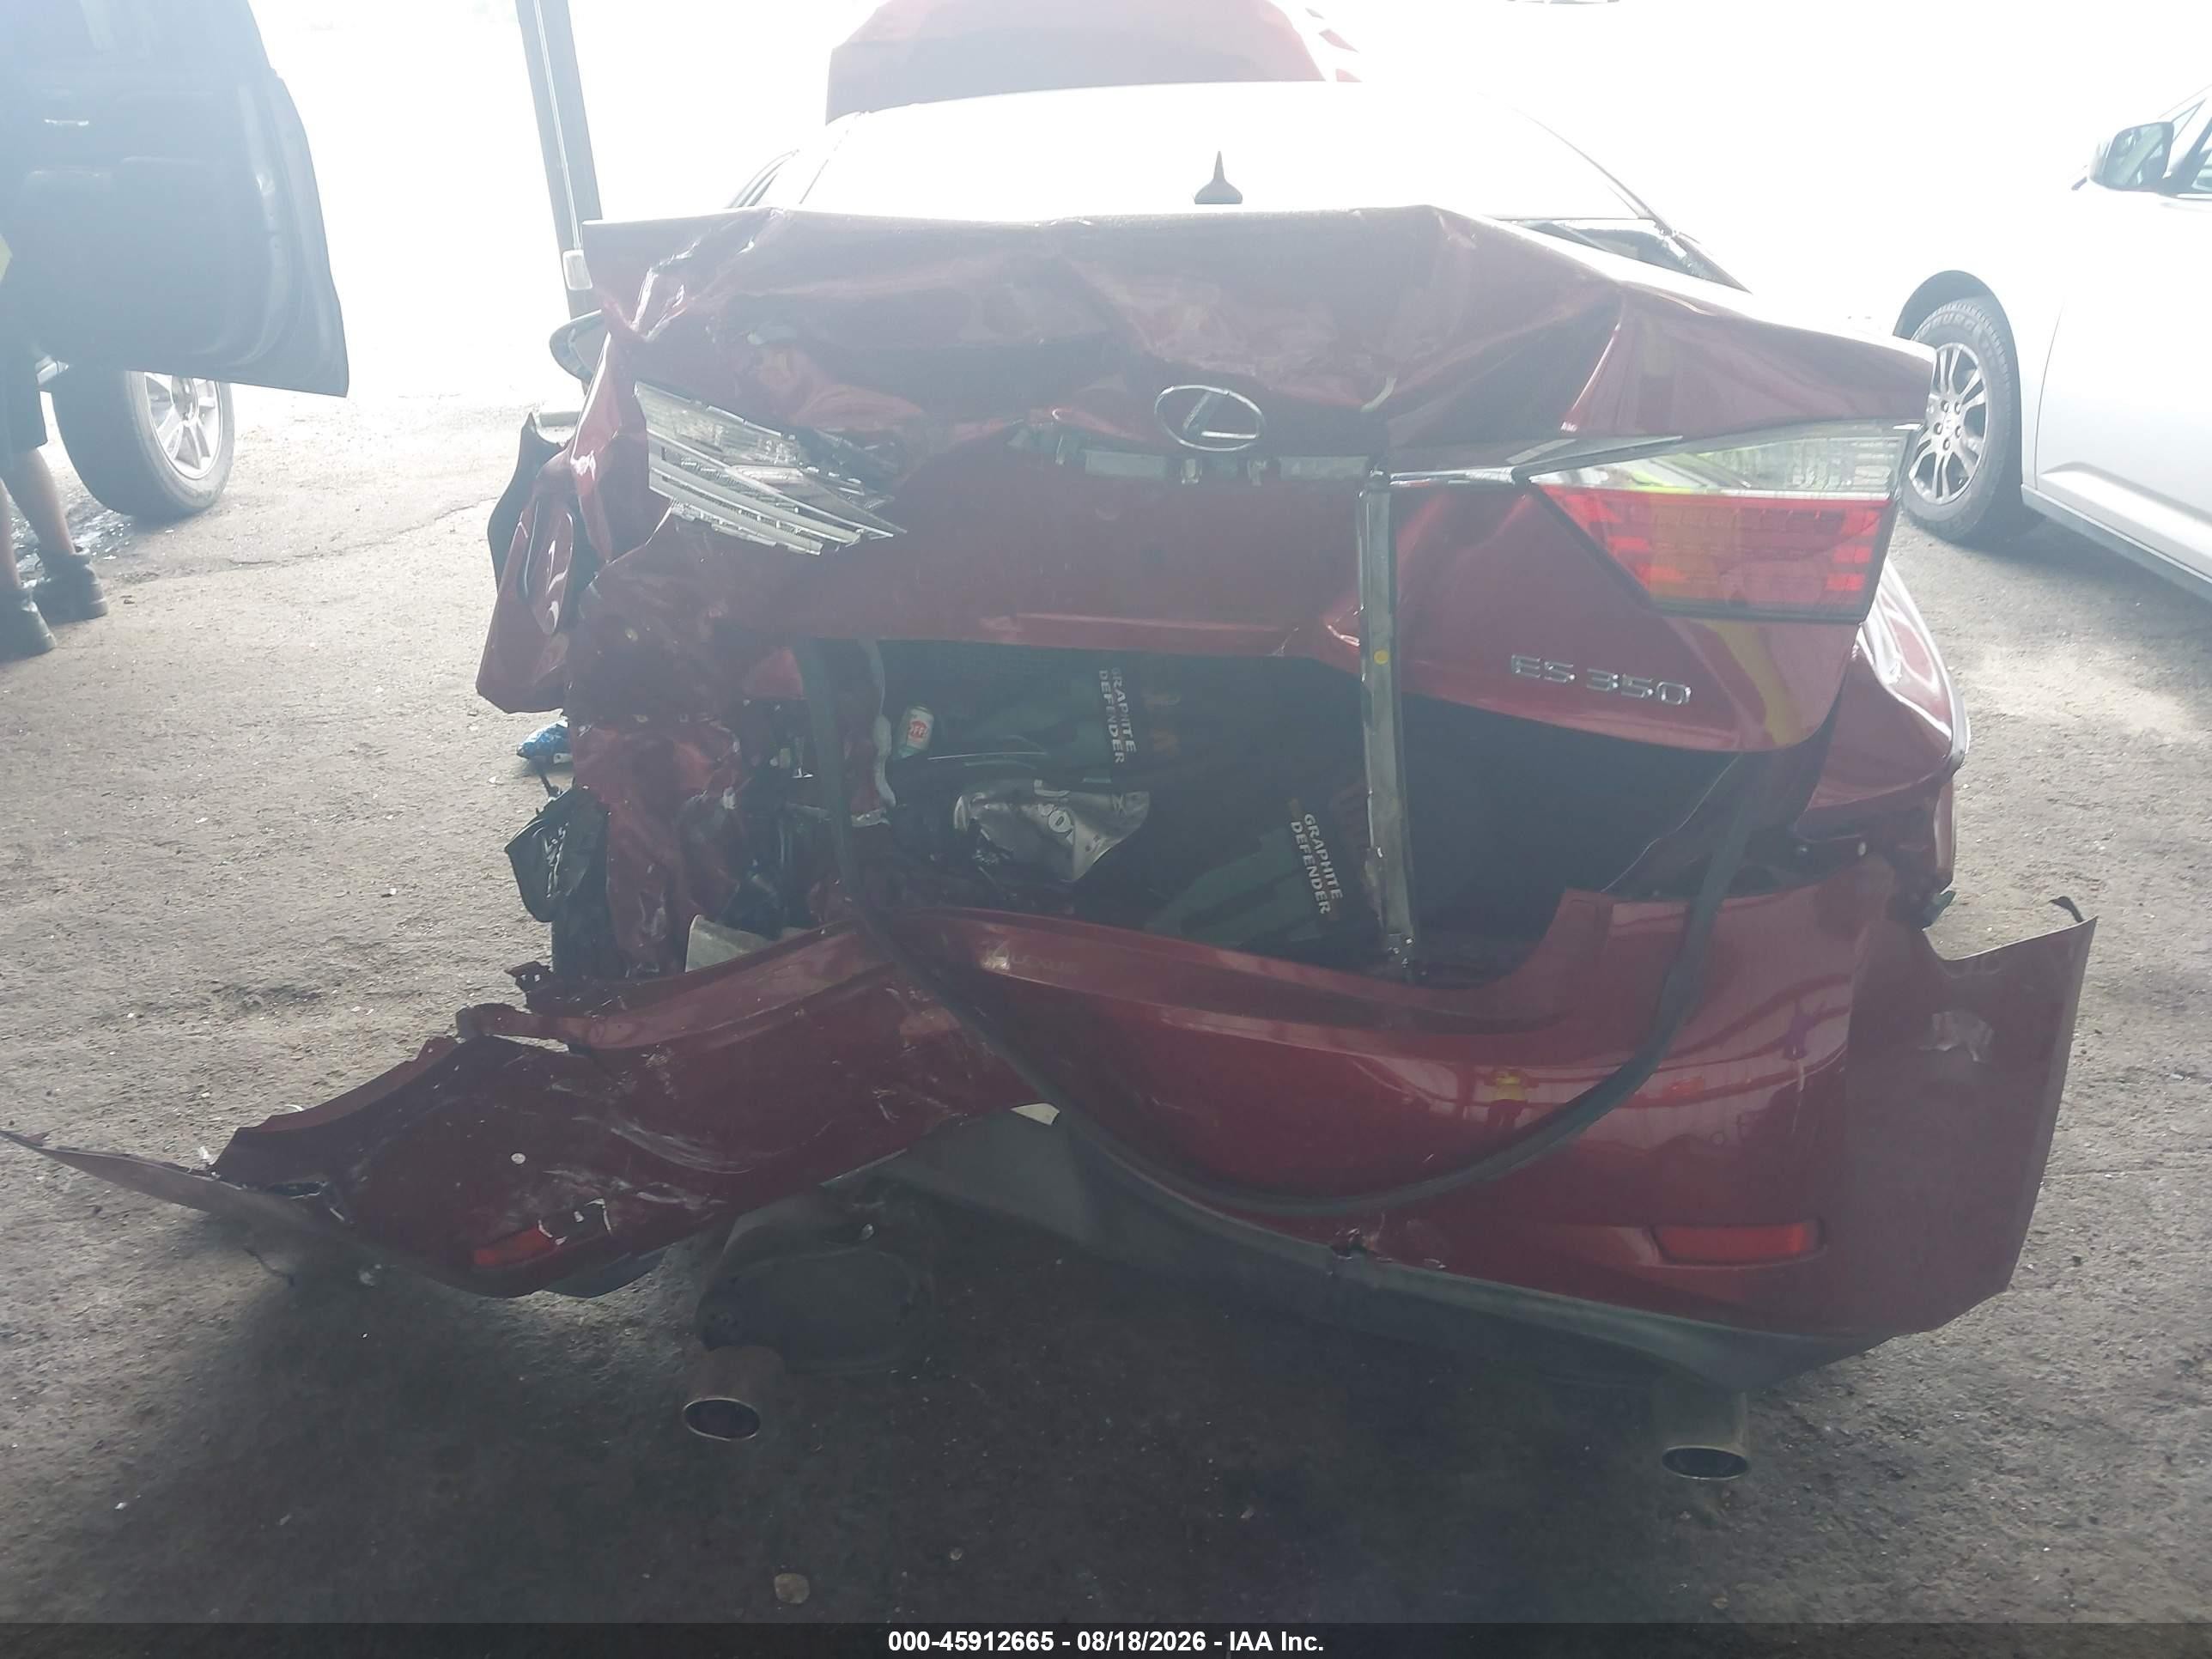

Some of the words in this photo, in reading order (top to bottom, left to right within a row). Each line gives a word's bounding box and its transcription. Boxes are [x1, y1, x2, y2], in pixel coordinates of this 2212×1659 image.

[1099, 670, 1126, 763] DEFENDER
[1112, 667, 1137, 752] GRAPHITE
[1511, 654, 1576, 684] ES
[1587, 667, 1692, 705] 350
[1291, 821, 1332, 915] DEFENDER
[1304, 813, 1344, 900] GRAPHITE
